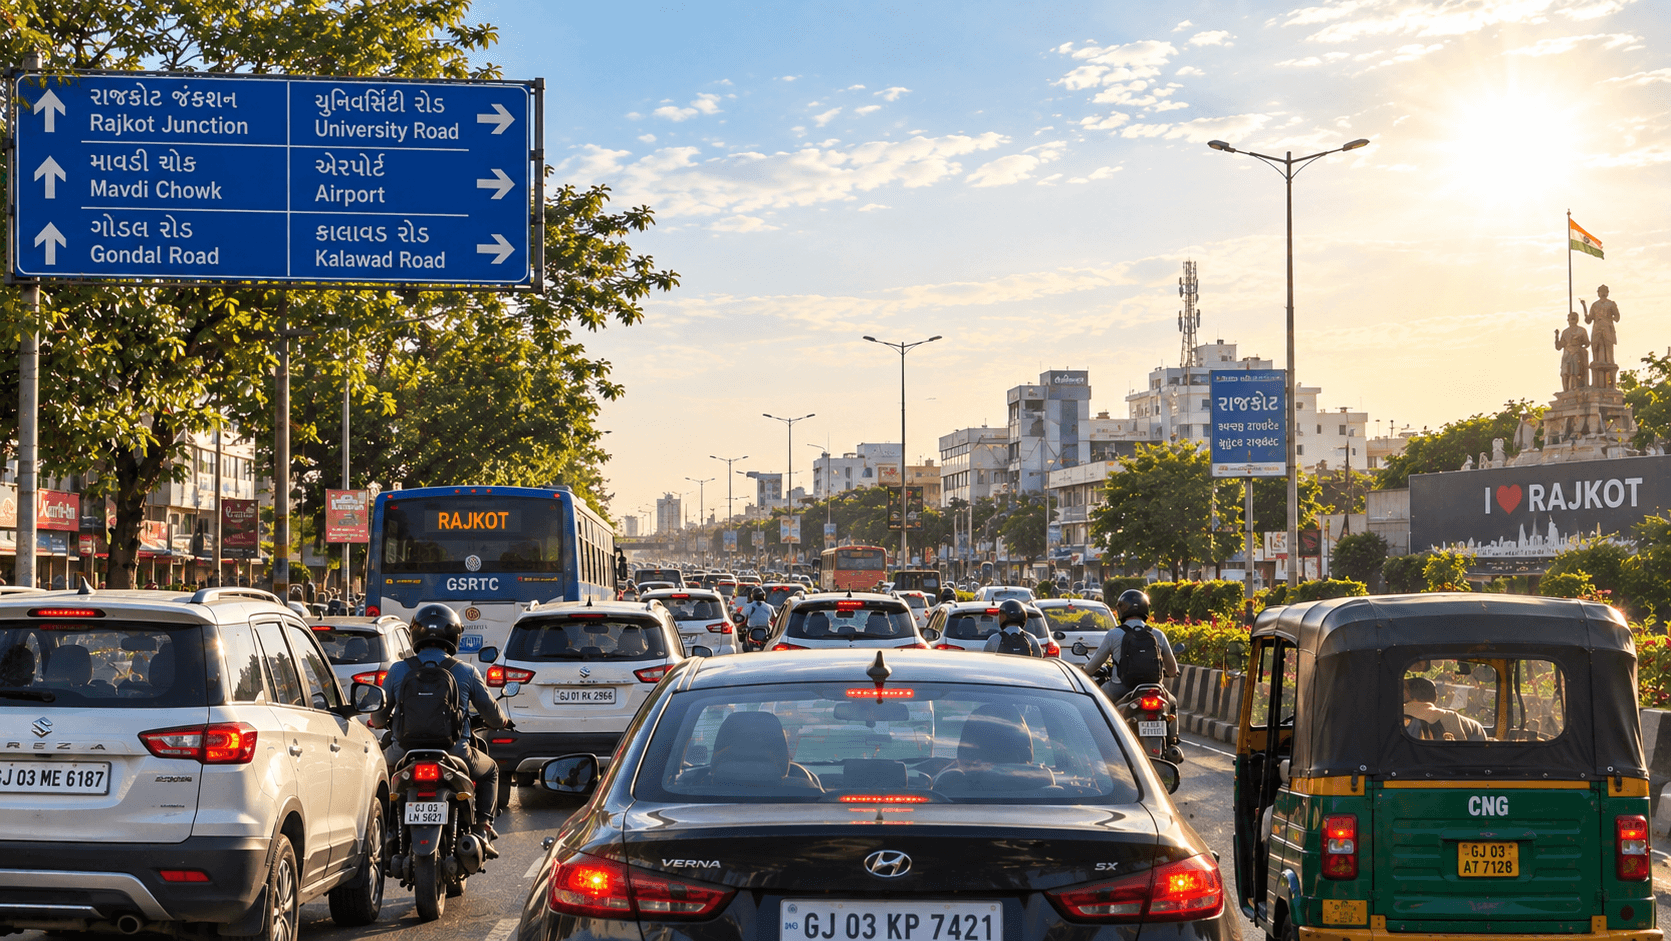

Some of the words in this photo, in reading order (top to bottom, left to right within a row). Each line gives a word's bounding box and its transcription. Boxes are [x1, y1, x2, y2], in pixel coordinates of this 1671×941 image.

[90, 82, 163, 107] રાજકોટ
[171, 84, 238, 109] જંકશન
[414, 89, 445, 114] રોડ
[90, 113, 155, 136] Rajkot
[161, 115, 248, 135] Junction
[315, 119, 408, 143] University
[414, 121, 459, 140] Road
[90, 148, 149, 172] માવડી
[158, 148, 197, 173] ચોક
[315, 151, 385, 177] એરપોર્ટ
[90, 179, 149, 198] Mavdi
[155, 180, 223, 200] Chowk
[314, 184, 386, 207] Airport
[90, 213, 149, 238] ગોડલ
[159, 214, 193, 239] રોડ
[315, 225, 388, 243] કાલાવડ
[397, 219, 430, 243] રોડ
[90, 244, 162, 264] Gondal
[169, 246, 219, 265] Road
[315, 249, 393, 268] Kalawad
[399, 250, 445, 269] Road
[1218, 390, 1278, 412] રાજકોટ
[1484, 487, 1491, 515] I
[1528, 477, 1643, 512] RAJKOT
[438, 511, 510, 530] RAJKOT
[446, 577, 499, 591] GSRTC
[559, 691, 570, 701] GJ
[570, 691, 580, 701] 01
[0, 768, 13, 786] J
[16, 769, 36, 786] 03
[39, 769, 62, 787] ME
[66, 770, 105, 788] 6187
[414, 803, 425, 813] GJ
[427, 803, 438, 813] 03
[1468, 795, 1509, 817] CNG
[408, 813, 420, 822] LN
[1471, 844, 1486, 858] GJ
[1490, 845, 1505, 858] 03
[661, 858, 721, 869] VERNA
[1094, 862, 1119, 871] SX
[1463, 860, 1479, 874] AT
[1482, 860, 1513, 874] 7128
[804, 912, 836, 940] GJ
[845, 912, 877, 940] 03
[887, 913, 920, 940] KP
[930, 913, 992, 941] 7421
